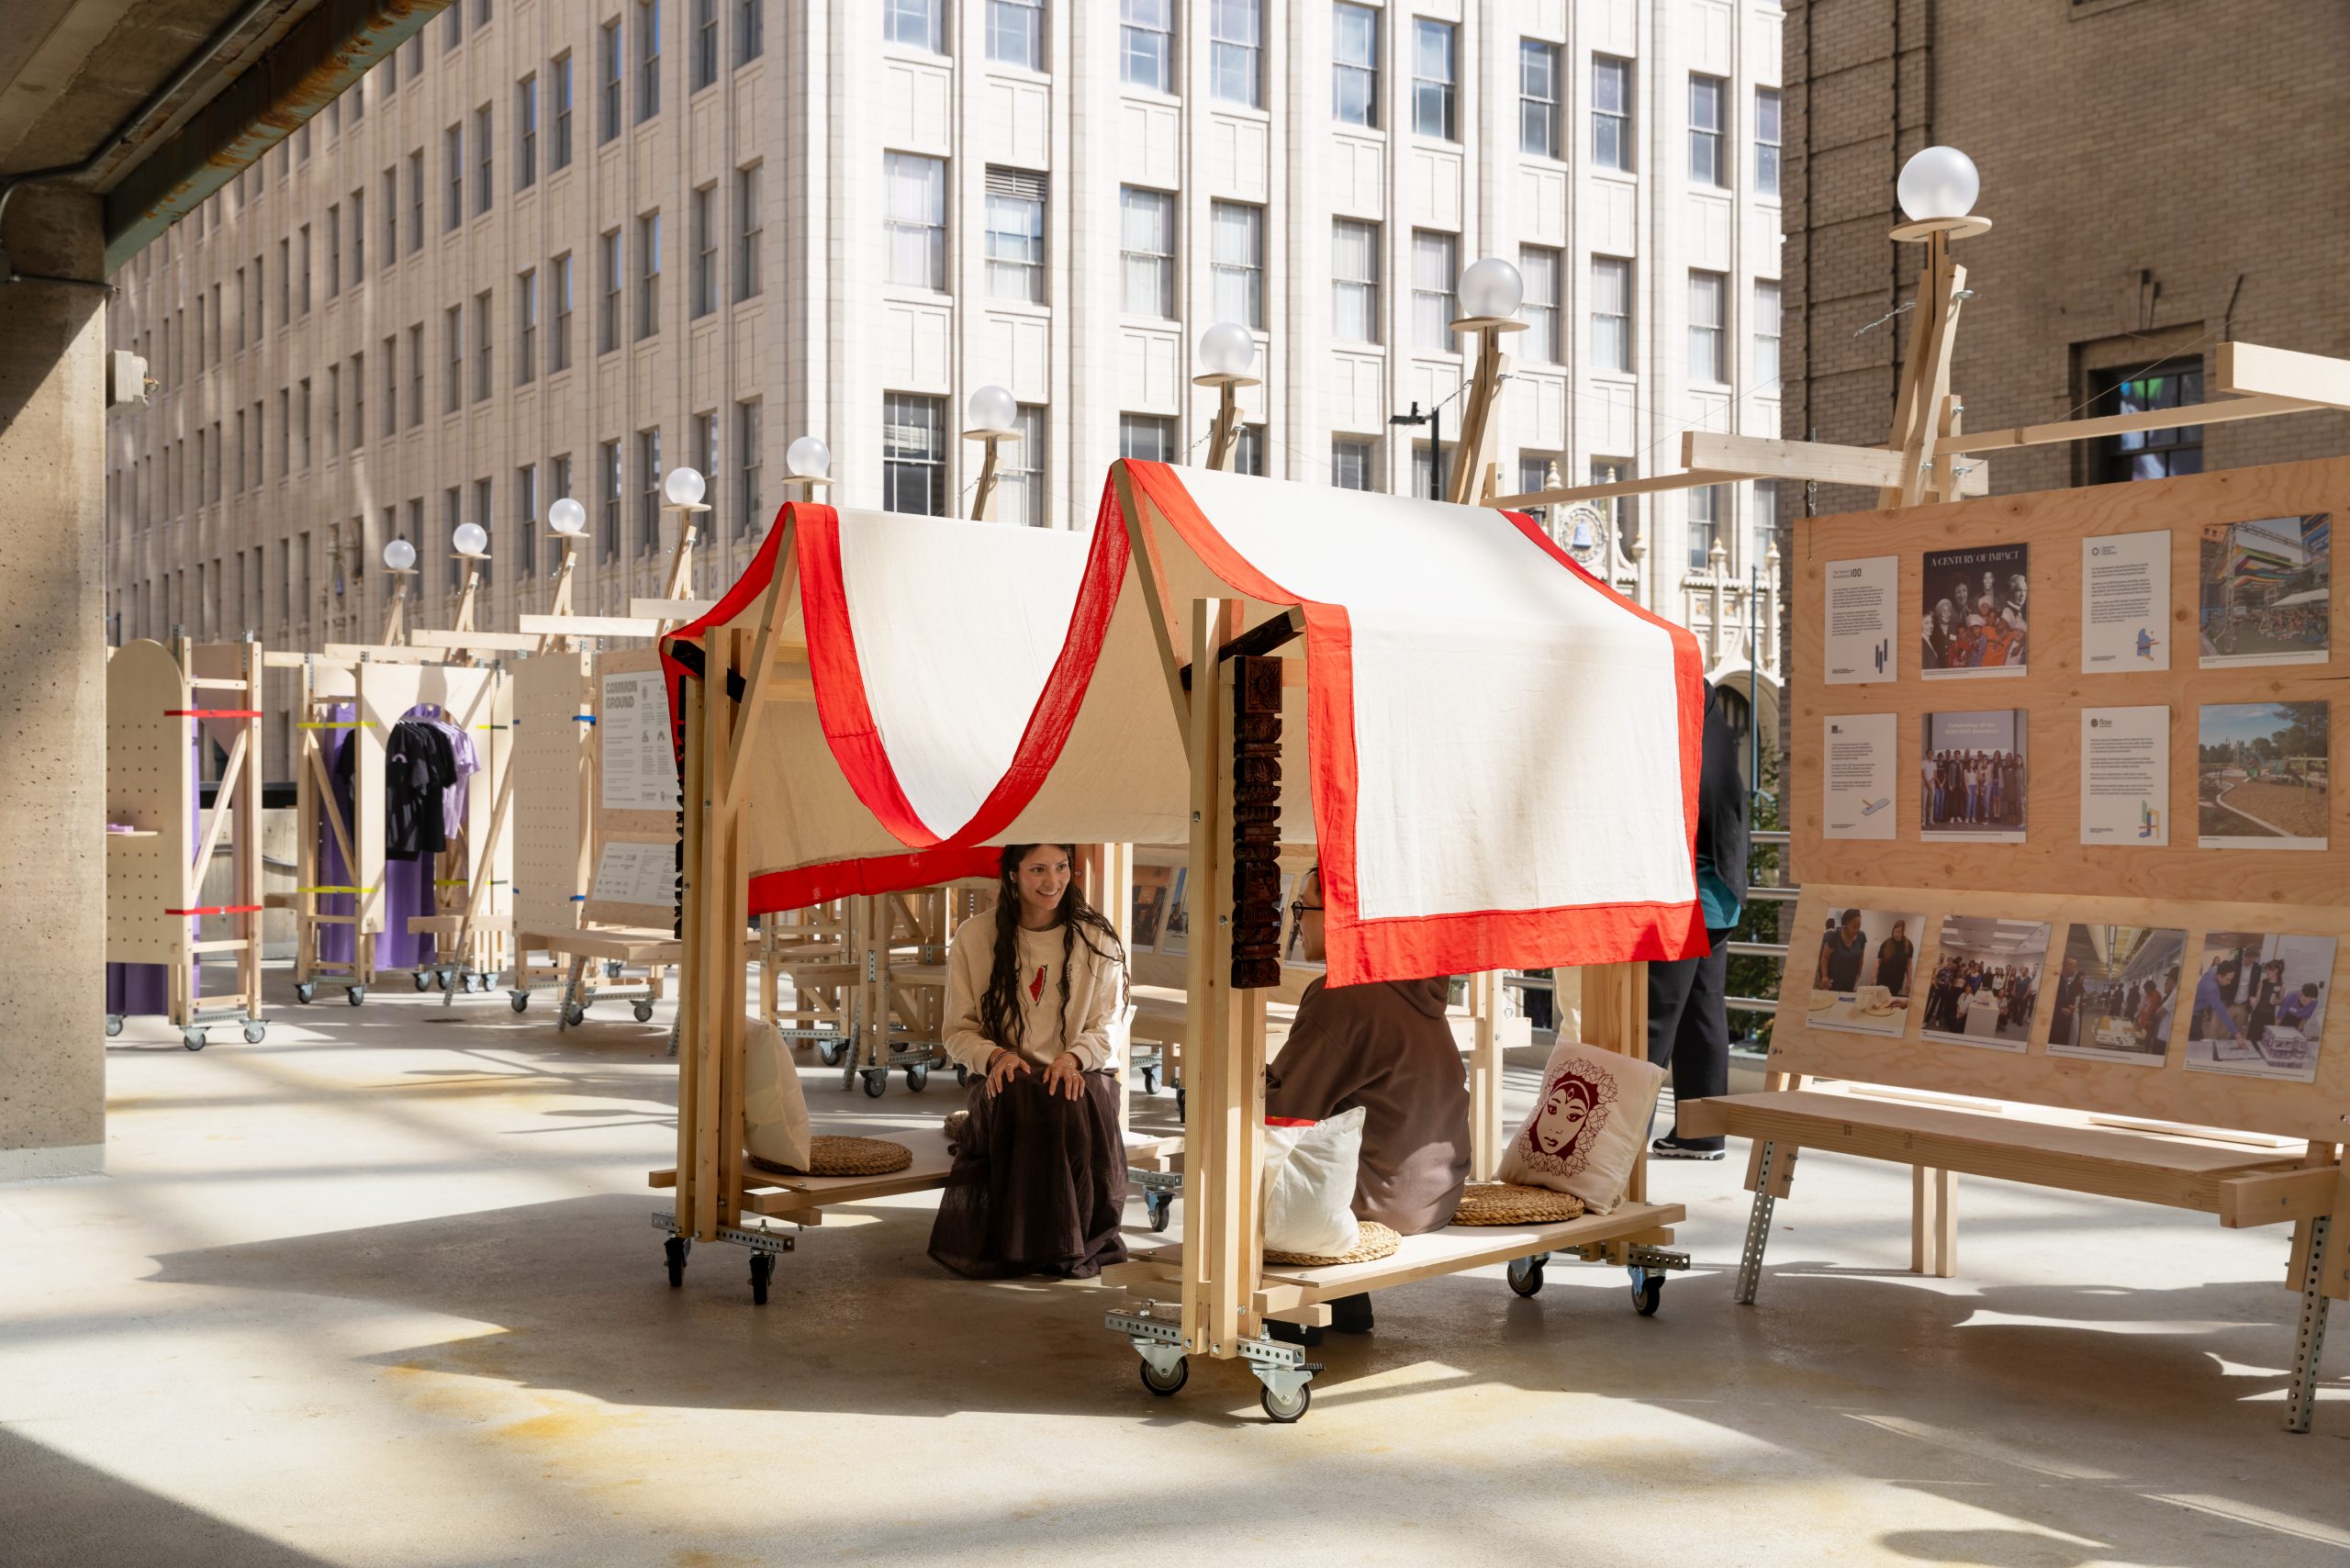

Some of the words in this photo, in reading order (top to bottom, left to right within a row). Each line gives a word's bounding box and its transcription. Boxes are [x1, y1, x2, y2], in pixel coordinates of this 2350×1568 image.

[1930, 558, 1937, 566] A
[1938, 554, 1974, 566] CENTURY
[1976, 554, 1988, 563] OF
[1988, 551, 2020, 562] IMPACT
[1851, 568, 1862, 578] 100
[606, 680, 638, 695] COMMON
[606, 696, 634, 709] GROUND
